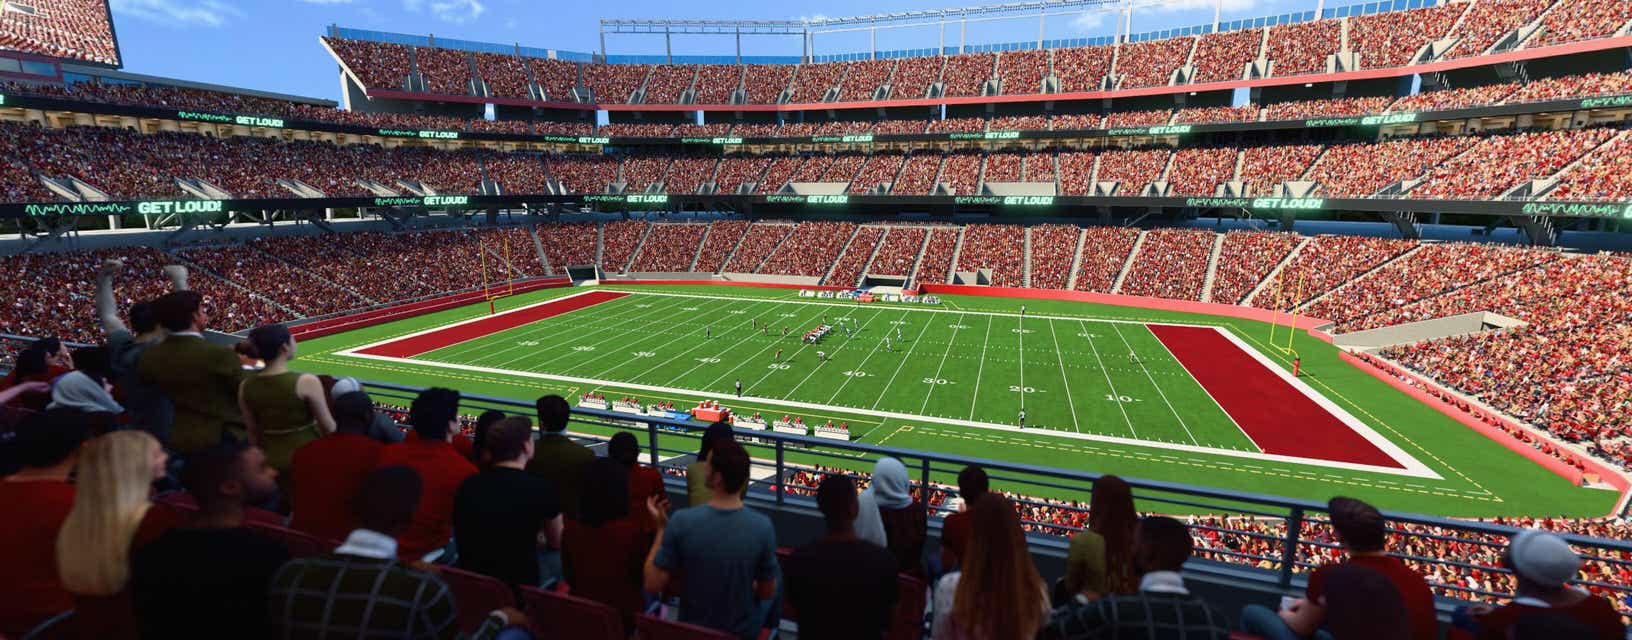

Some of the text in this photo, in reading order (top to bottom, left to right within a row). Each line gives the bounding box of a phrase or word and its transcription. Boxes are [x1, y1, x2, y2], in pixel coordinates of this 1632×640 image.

[236, 115, 284, 128] GET LOUD!
[1361, 113, 1417, 125] GET LOUD!
[1149, 126, 1167, 134] GET
[435, 131, 458, 139] LOUD!
[424, 196, 468, 205] GET LOUD!
[627, 195, 668, 203] GET LOUD!
[807, 195, 848, 203] GET LOUD!
[1004, 196, 1054, 205] GET LOUD!
[138, 200, 222, 214] GET LOUD!
[1253, 198, 1324, 209] GET LOUD!
[842, 370, 866, 378] 40
[922, 377, 948, 385] 30
[1008, 385, 1036, 393] 20
[1104, 394, 1133, 403] 10
